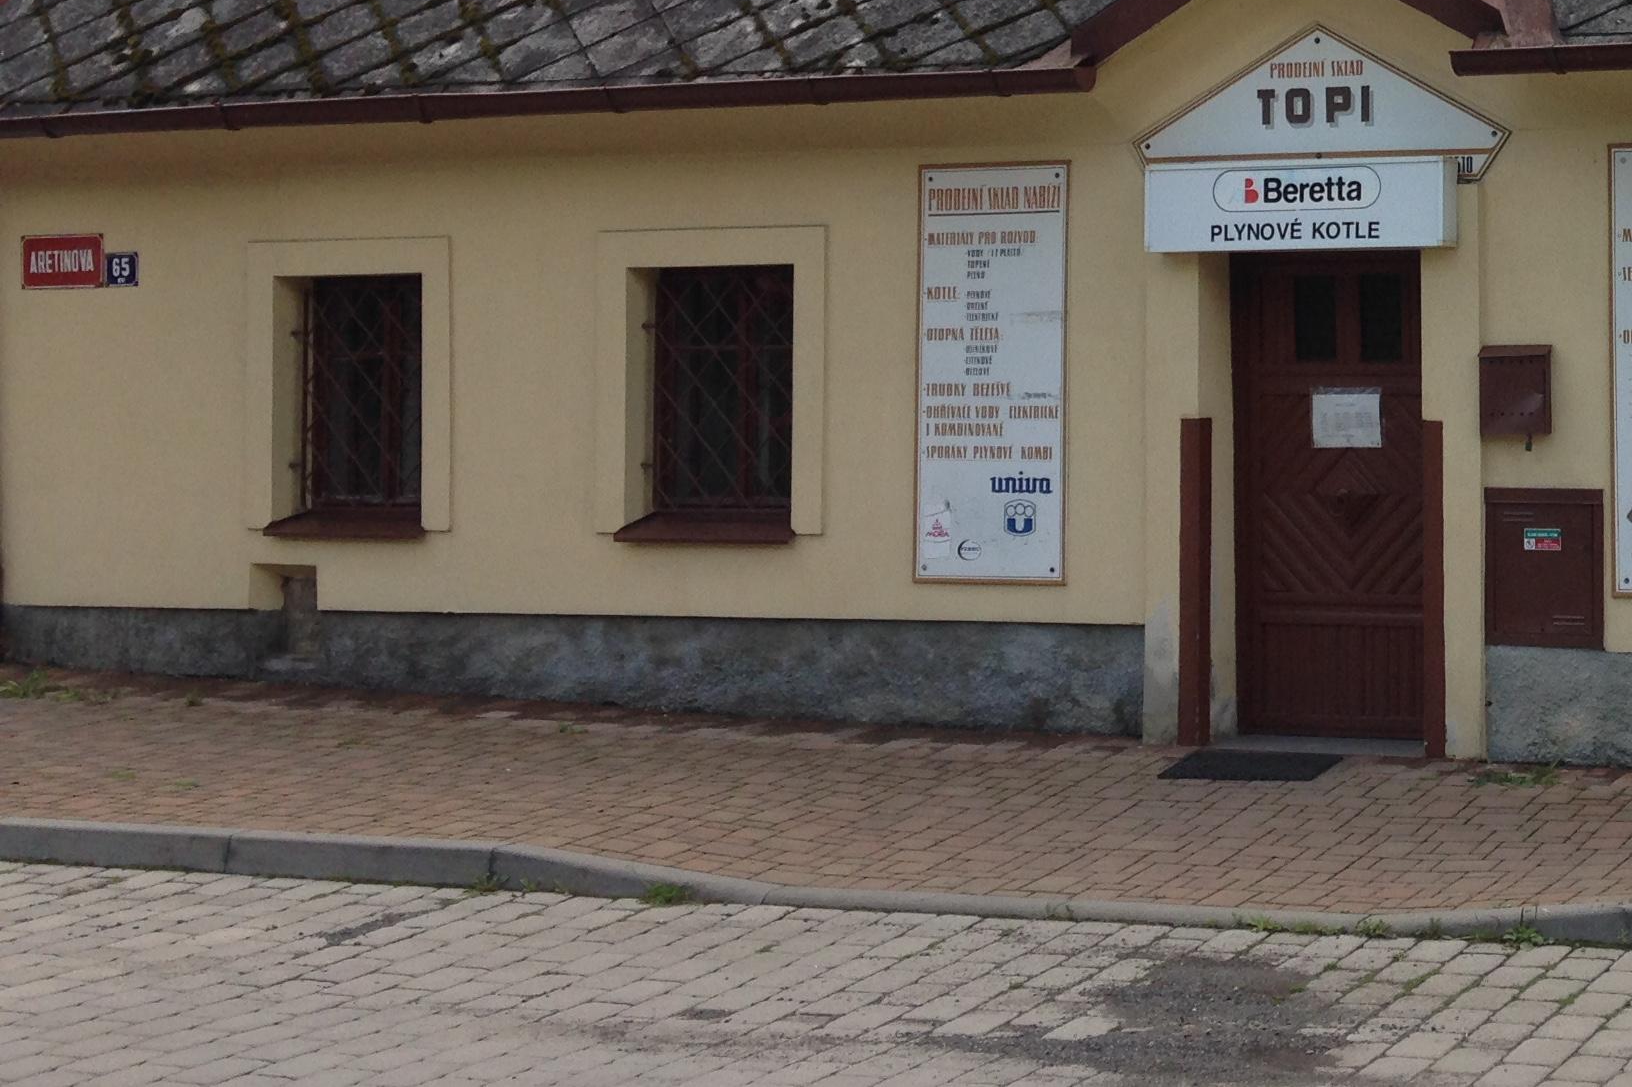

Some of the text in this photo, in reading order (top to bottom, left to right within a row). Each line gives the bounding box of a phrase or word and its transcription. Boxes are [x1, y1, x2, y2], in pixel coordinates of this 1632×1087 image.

[1269, 59, 1364, 79] PRODEJNÍ SKLAD
[1256, 85, 1374, 130] TOPI
[928, 184, 986, 211] PRODEJNÍ
[988, 186, 1019, 210] SKLAD
[1262, 176, 1363, 204] Beretta
[978, 231, 997, 245] PRO
[1210, 218, 1380, 242] PLYNOVÉ KOTLE
[112, 258, 130, 277] 65
[975, 405, 1000, 419] VODY
[1021, 446, 1053, 459] KOMBI
[989, 471, 1053, 494] univa
